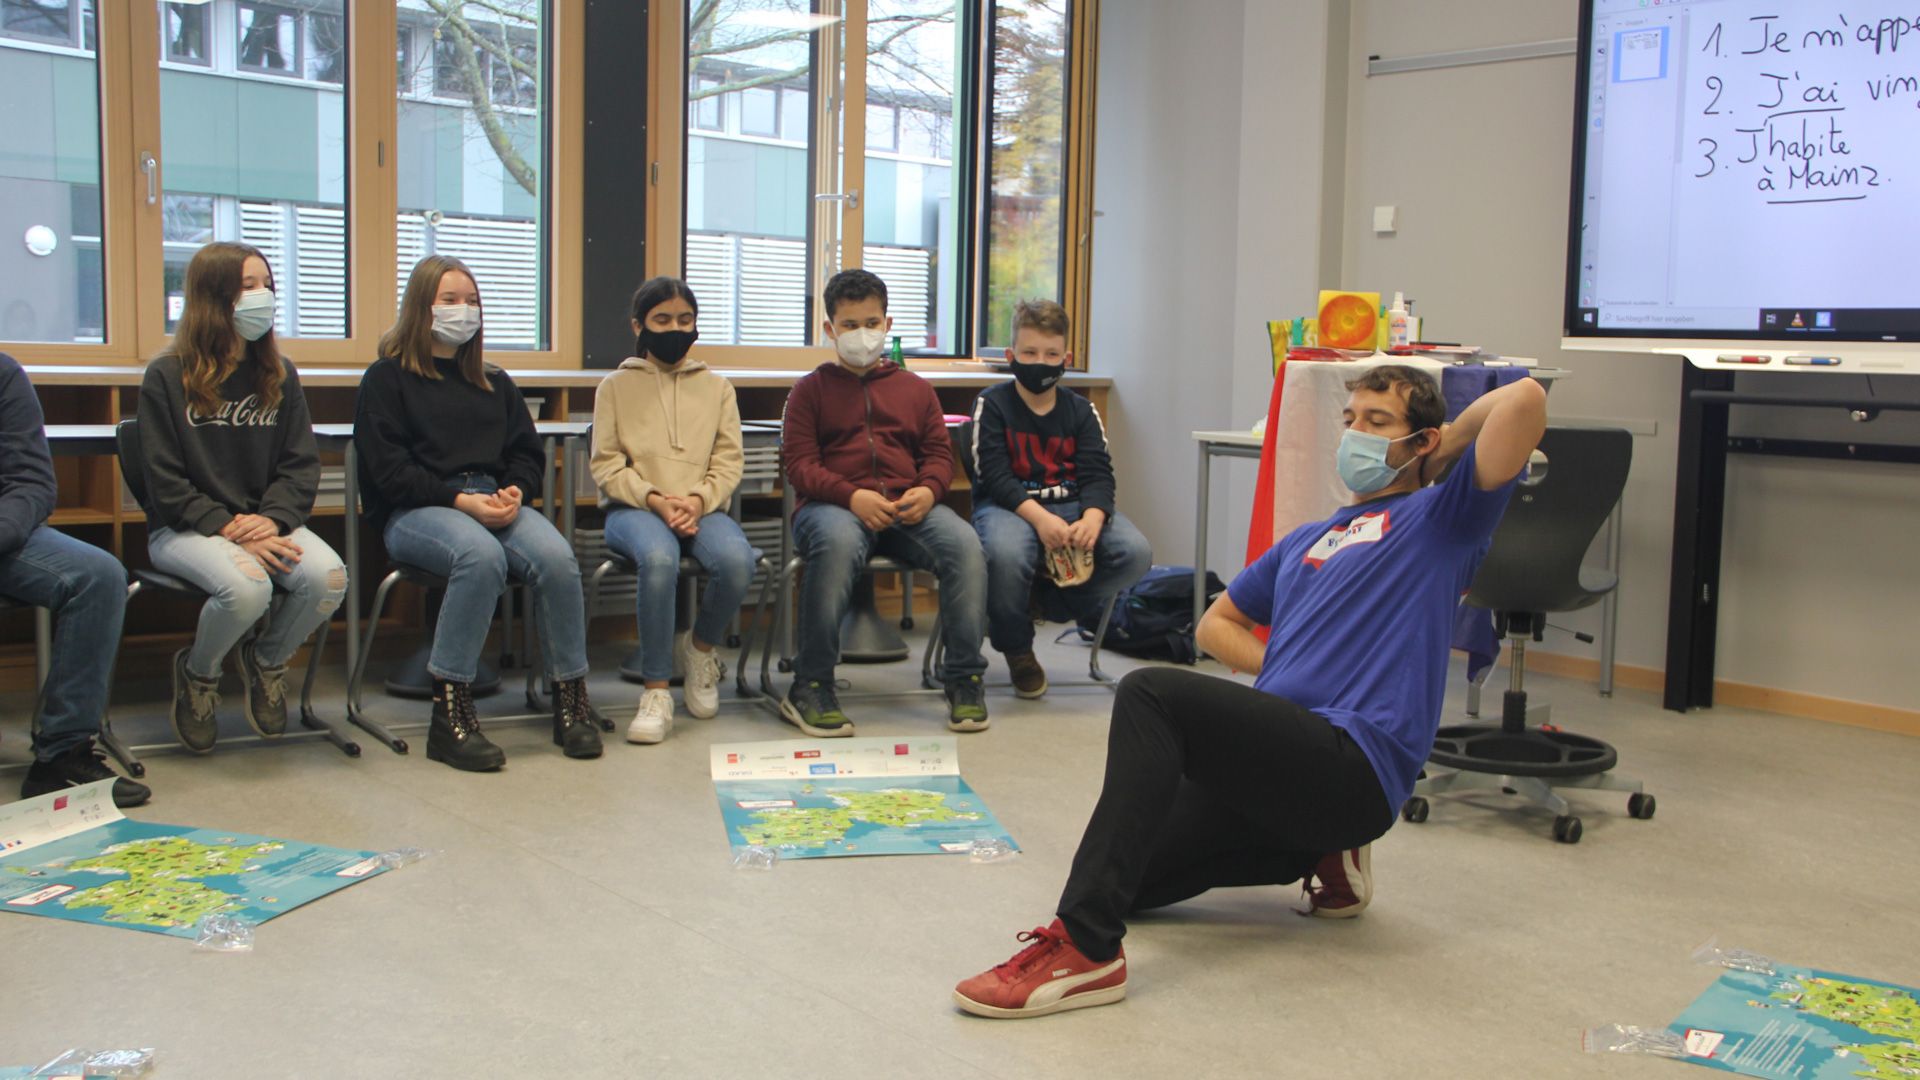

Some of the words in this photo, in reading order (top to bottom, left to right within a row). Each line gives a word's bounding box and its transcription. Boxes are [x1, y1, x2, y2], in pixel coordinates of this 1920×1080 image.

[1702, 22, 1727, 58] 1.
[1741, 15, 1791, 55] Je
[1703, 75, 1733, 115] 2.
[1757, 71, 1839, 108] J'ai
[1867, 74, 1920, 100] vin
[1695, 138, 1729, 178] 3.
[1757, 166, 1776, 191] à
[186, 393, 278, 428] Ca-Cola
